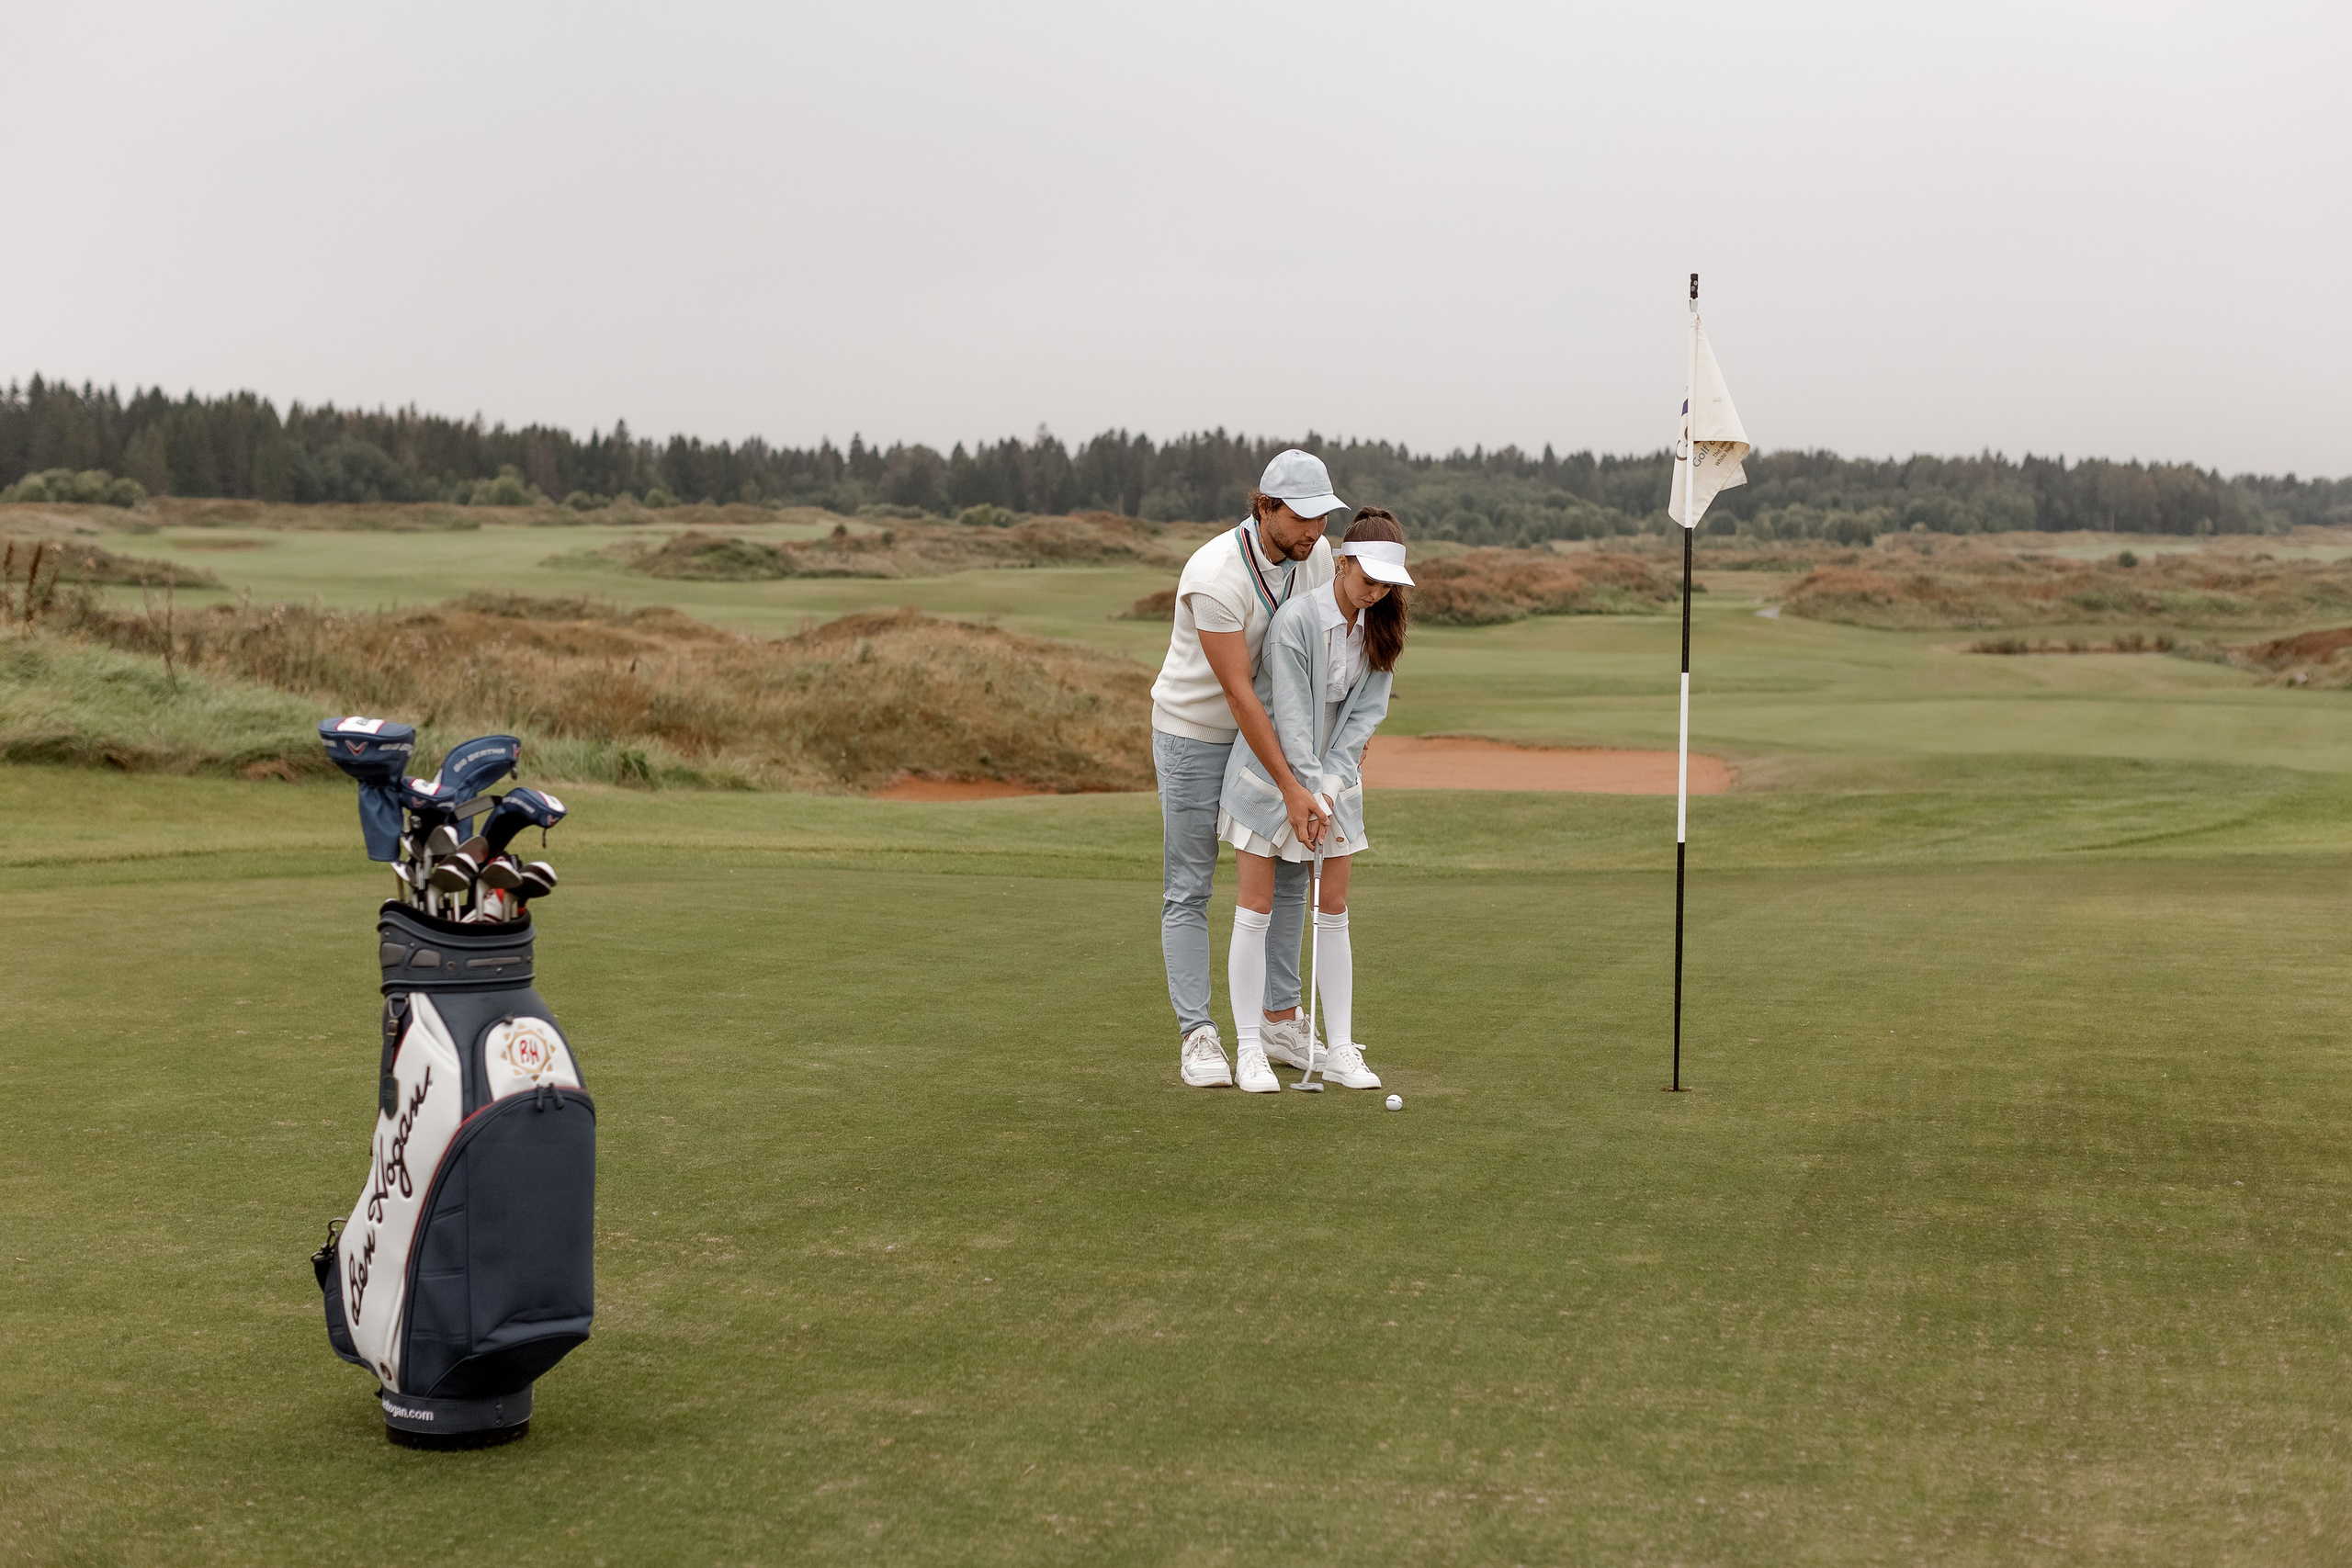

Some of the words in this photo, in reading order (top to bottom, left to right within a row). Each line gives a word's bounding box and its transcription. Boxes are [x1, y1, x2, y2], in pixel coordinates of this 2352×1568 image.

[1693, 443, 1710, 467] Golf
[1713, 448, 1722, 457] The
[1714, 453, 1727, 466] White
[350, 1229, 376, 1327] Ben
[368, 1066, 430, 1224] Hogan
